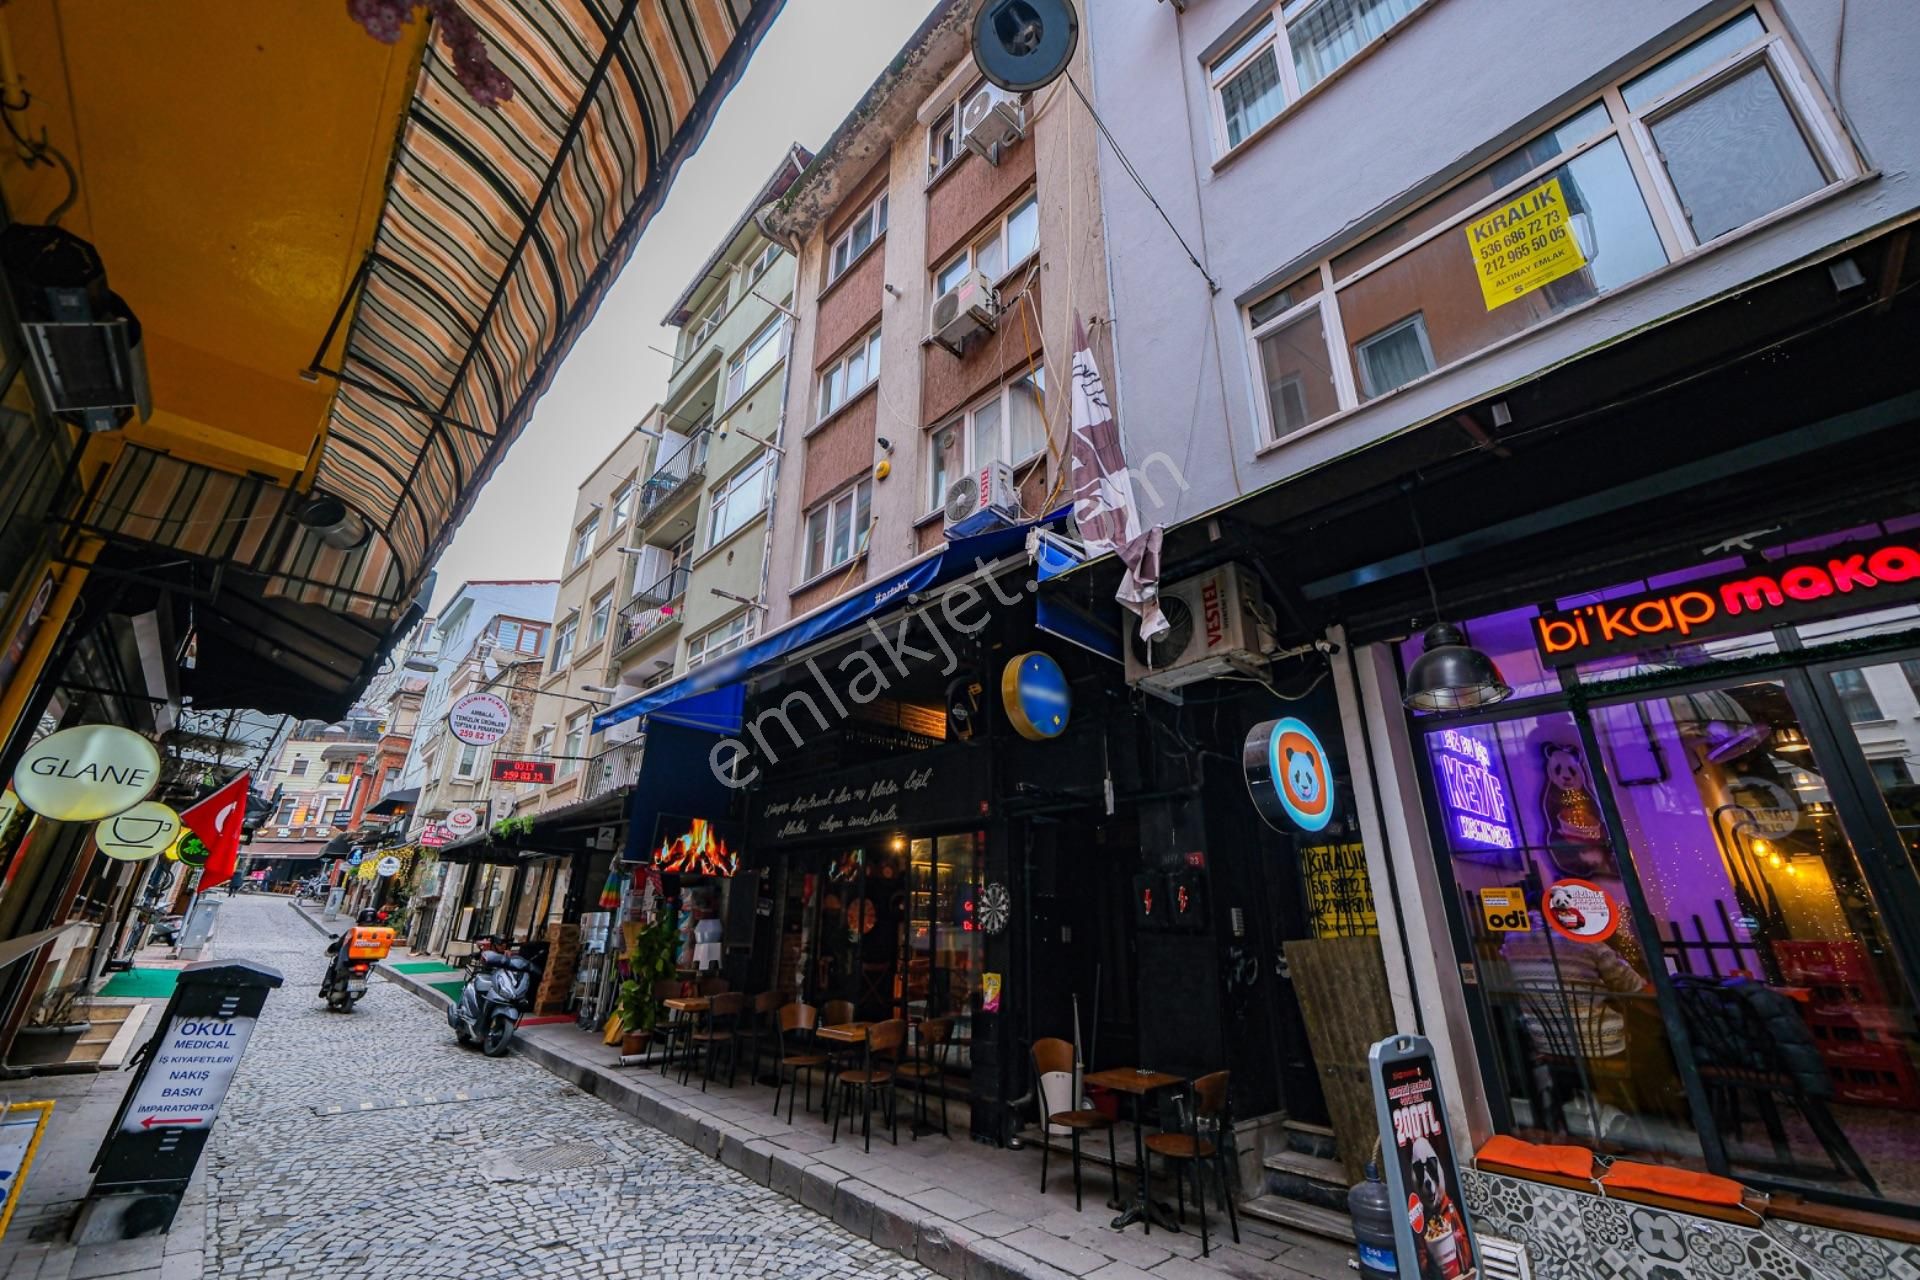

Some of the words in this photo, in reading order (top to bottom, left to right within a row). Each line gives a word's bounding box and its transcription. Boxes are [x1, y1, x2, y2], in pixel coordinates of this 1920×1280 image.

[1480, 240, 1503, 260] 536
[1504, 227, 1526, 248] 686
[1527, 218, 1543, 236] 72
[1544, 209, 1560, 227] 73
[1484, 255, 1506, 276] 212
[1507, 243, 1531, 264] 965
[1531, 233, 1548, 252] 50
[1549, 224, 1566, 243] 05
[1495, 264, 1532, 288] ALTINAY
[1534, 248, 1566, 270] EMLAK
[980, 466, 989, 507] VESTEL
[1202, 576, 1223, 648] VESTEL
[471, 709, 495, 719] AMBALAJ
[453, 721, 473, 730] TOPTAN
[459, 729, 474, 738] 259
[475, 731, 485, 740] 82
[486, 732, 496, 742] 13
[30, 756, 150, 788] GLANE
[1488, 910, 1528, 929] odi
[180, 1022, 237, 1036] OKUL
[174, 1040, 230, 1050] MEDICAL
[159, 1055, 169, 1064] İŞ
[171, 1055, 234, 1064] KIYAFETLERİ
[169, 1070, 210, 1082] NAKIŞ
[161, 1087, 204, 1097] BASKI
[137, 1104, 216, 1113] İMPARATOR'DA
[1392, 1101, 1442, 1148] 200TL
